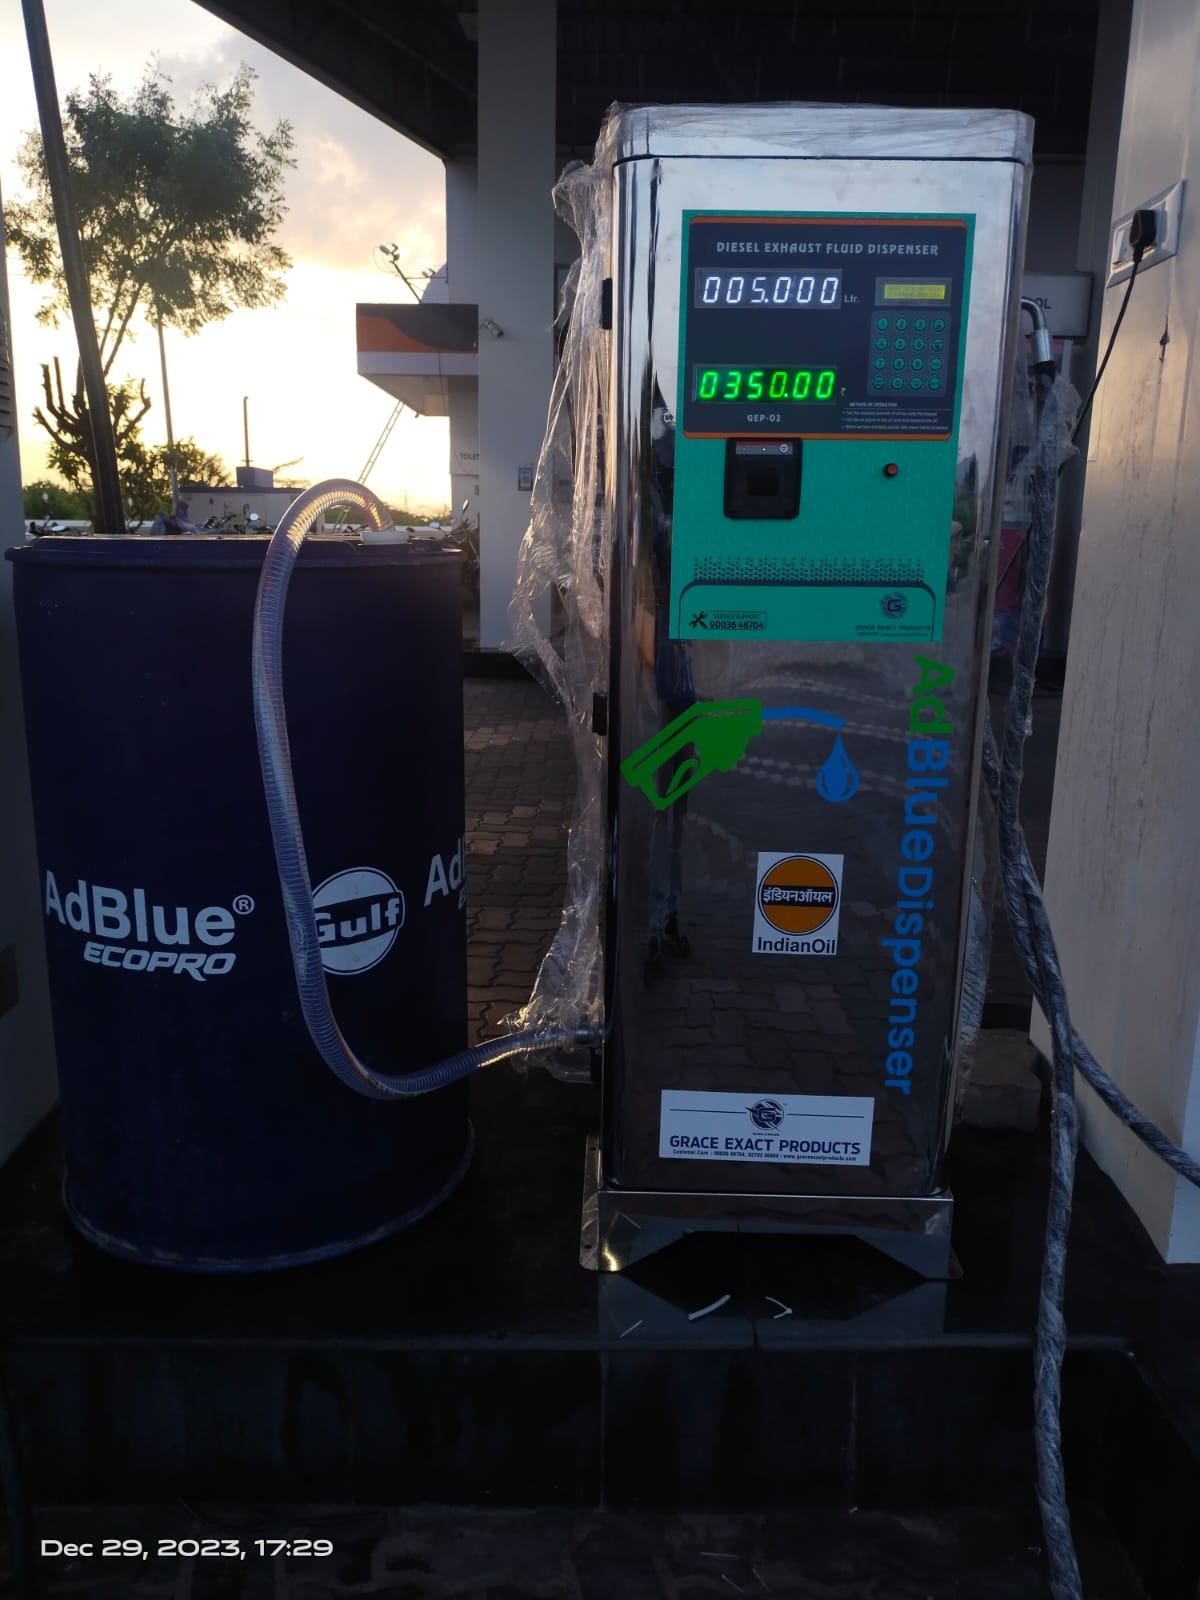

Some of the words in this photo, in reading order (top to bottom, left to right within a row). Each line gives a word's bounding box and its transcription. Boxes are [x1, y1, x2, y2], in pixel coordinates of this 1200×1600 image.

[716, 241, 760, 253] DIESEL
[764, 242, 822, 254] EXHAUST
[826, 243, 864, 255] FLUID
[868, 243, 939, 256] DISPENSER
[702, 276, 839, 304] 005.000
[844, 293, 860, 303] Ltr.
[699, 371, 836, 399] 0350.00
[746, 414, 781, 423] GEP-02
[709, 620, 737, 629] 90036
[763, 886, 833, 903] इंडियनऑयल
[757, 936, 836, 954] IndianOil
[83, 941, 237, 982] ECOPRO
[669, 1135, 719, 1149] GRACE
[724, 1138, 774, 1152] EXACT
[778, 1139, 861, 1155] PRODUCTS
